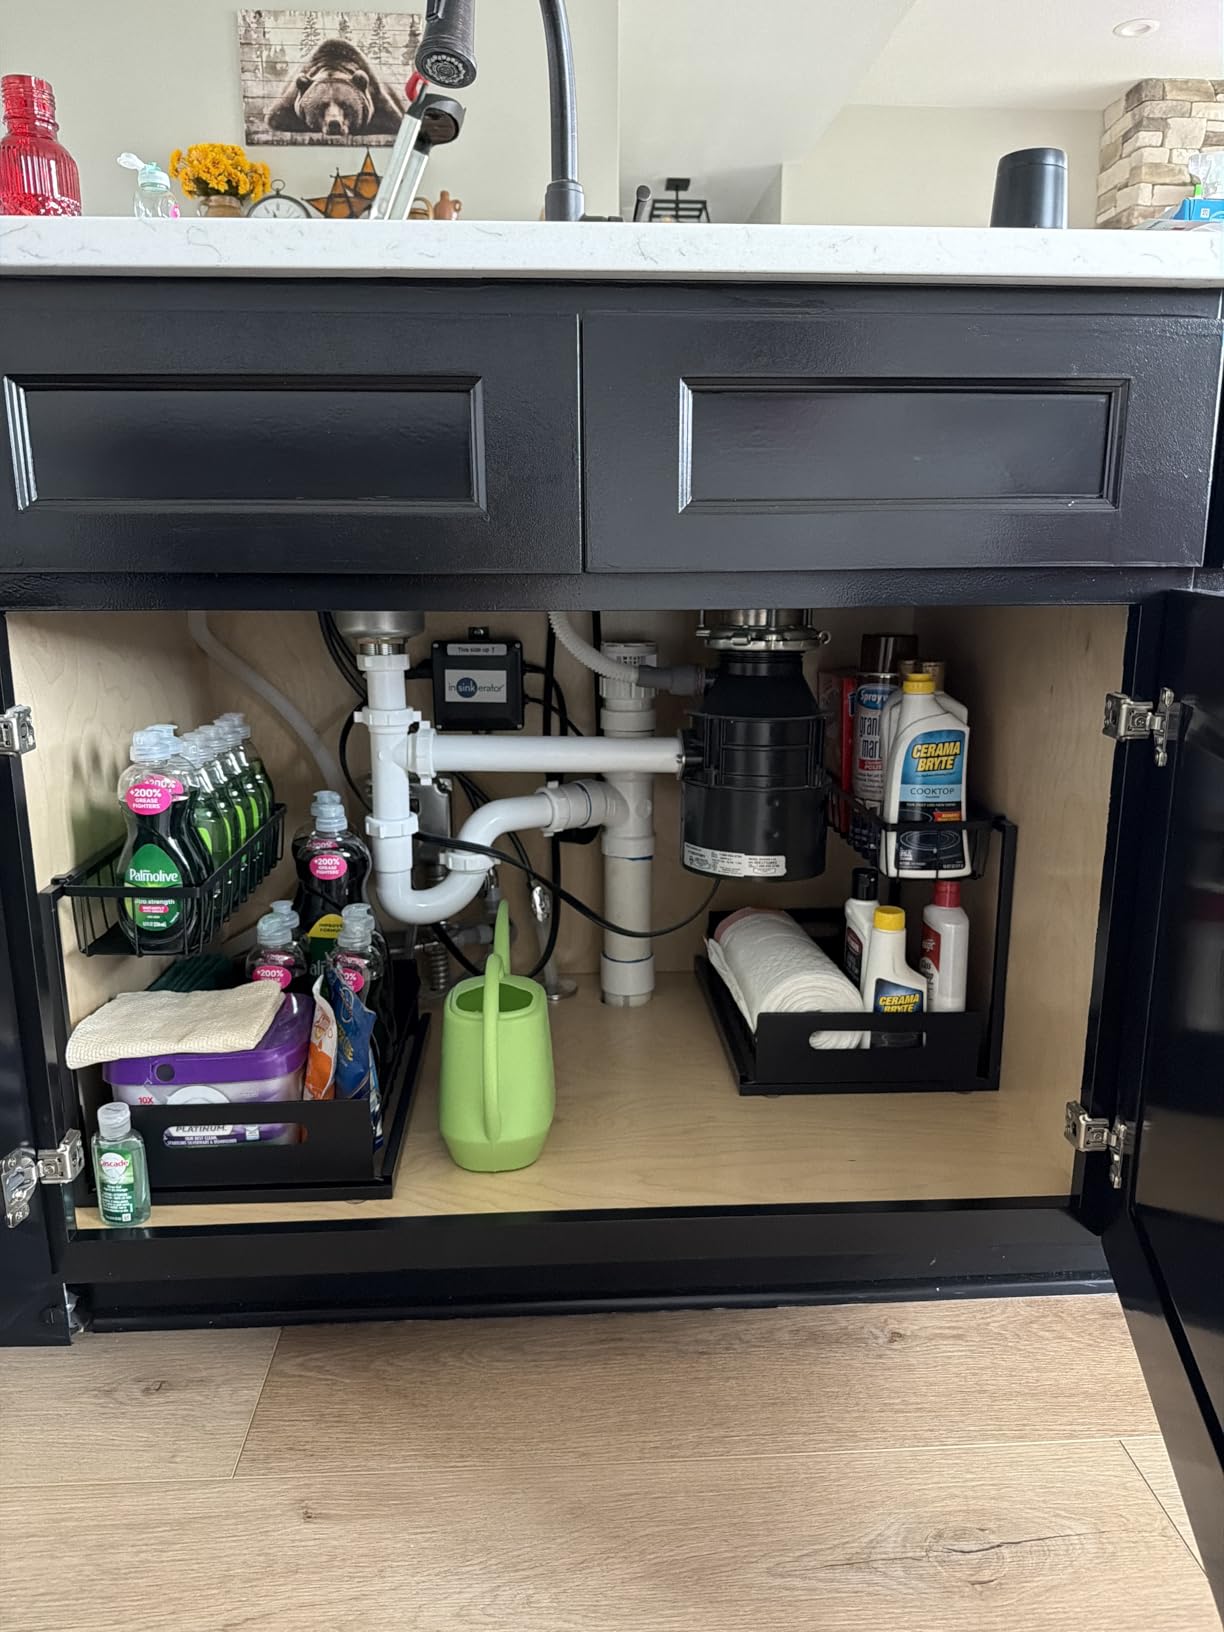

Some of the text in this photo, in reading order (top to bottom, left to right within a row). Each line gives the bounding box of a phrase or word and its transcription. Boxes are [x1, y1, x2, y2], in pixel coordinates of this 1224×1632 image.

[859, 715, 880, 737] grani
[911, 741, 961, 759] CERAMA
[916, 756, 955, 772] BRYTE
[910, 787, 955, 796] COOKTOP
[129, 868, 178, 882] Palmolive
[879, 994, 920, 1006] CERAMA
[138, 1096, 155, 1104] 10X
